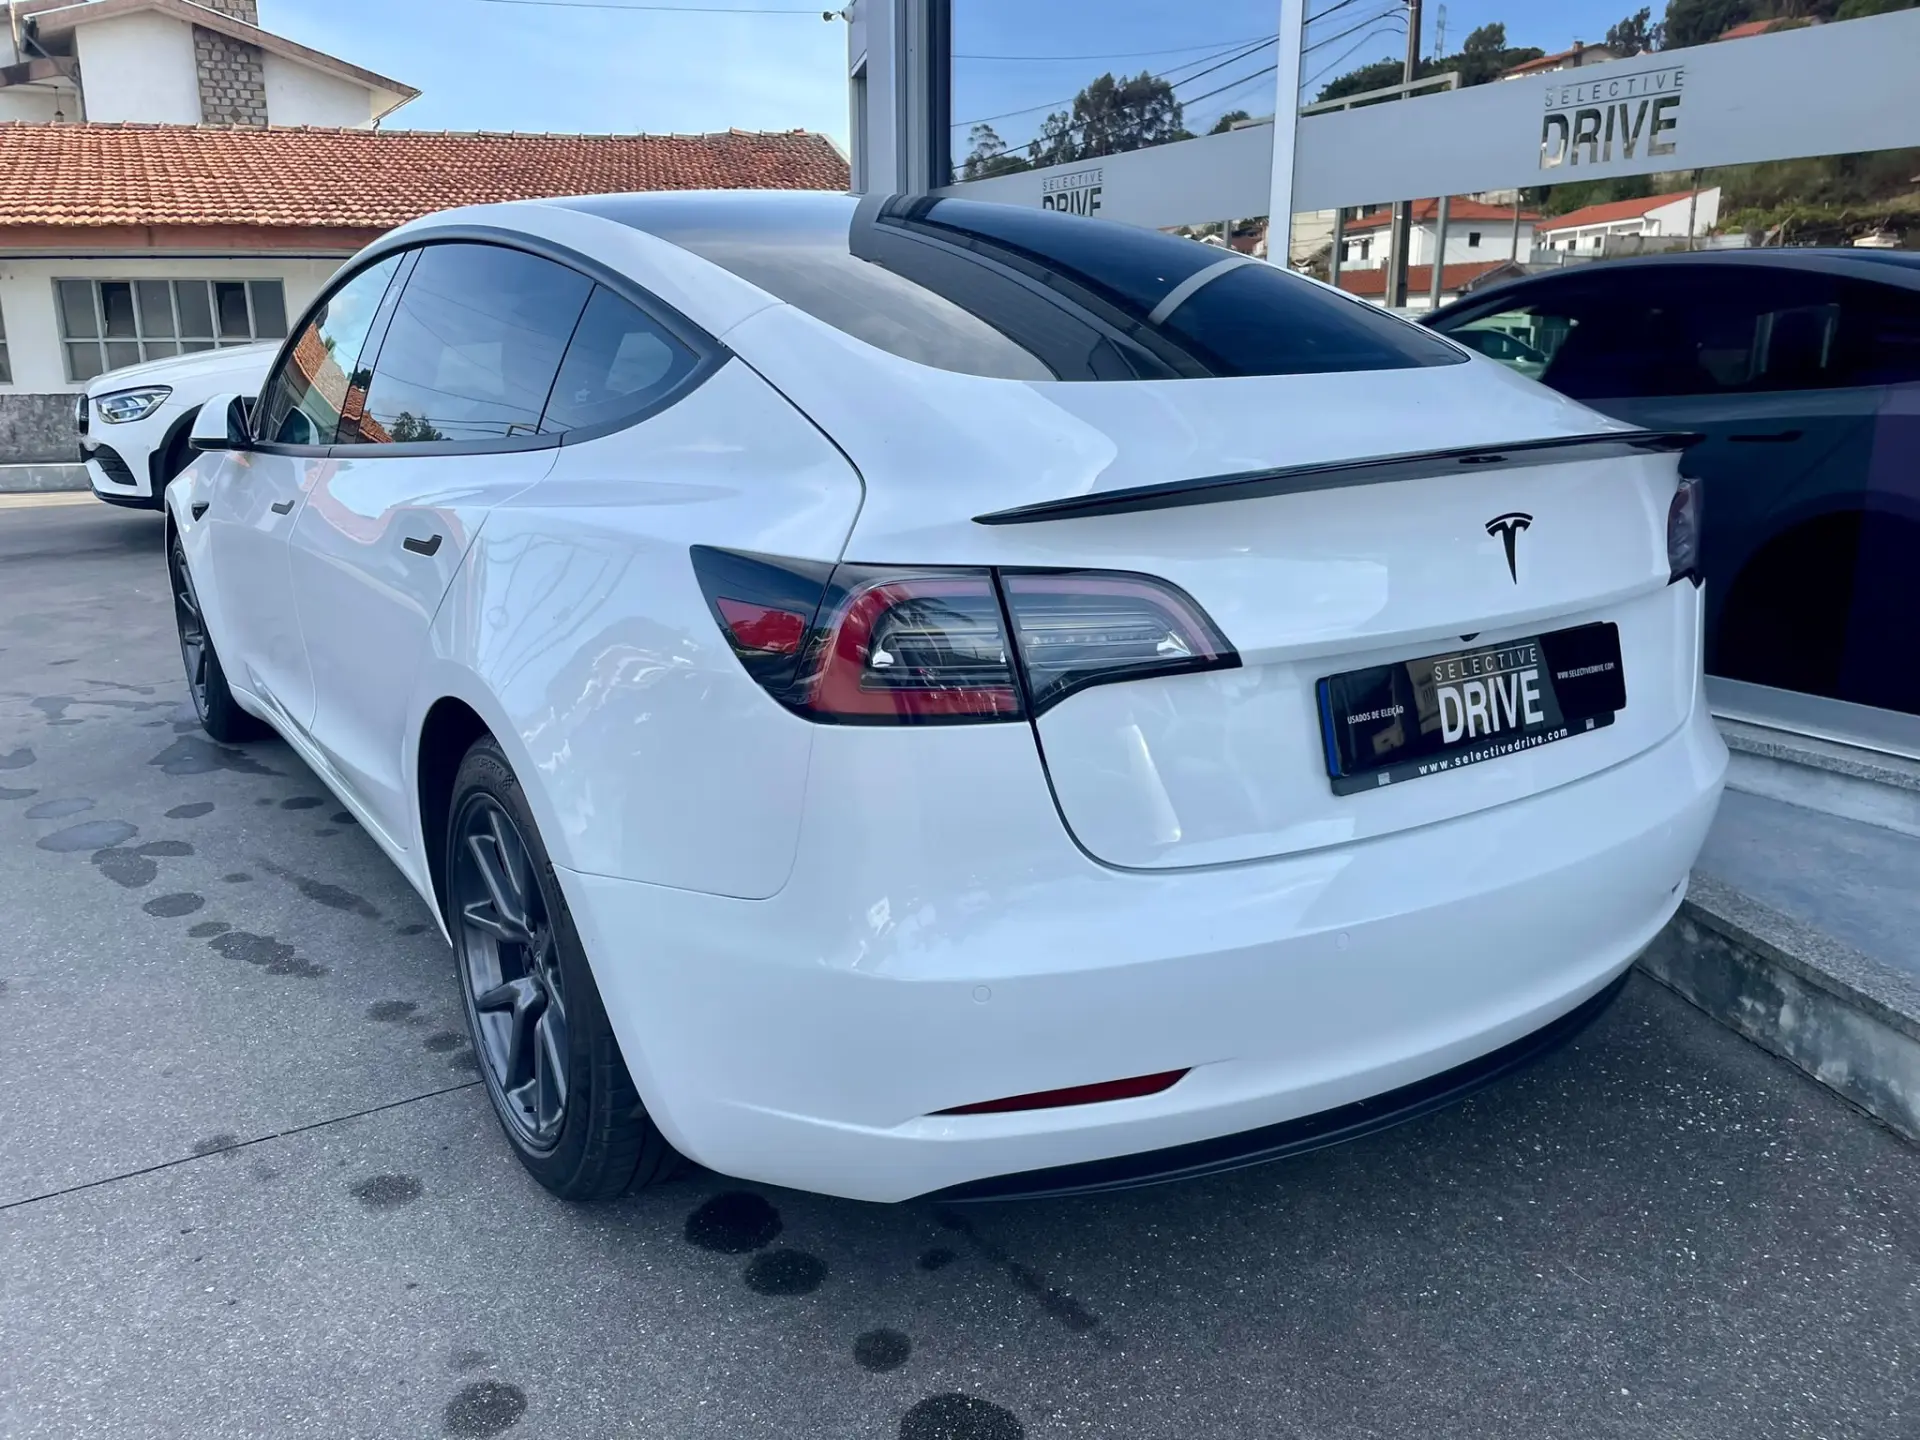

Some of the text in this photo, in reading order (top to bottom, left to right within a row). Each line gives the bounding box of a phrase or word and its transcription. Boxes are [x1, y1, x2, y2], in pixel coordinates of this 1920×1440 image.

[1544, 71, 1685, 108] SELECTIVE
[1539, 95, 1681, 170] DRIVE
[1043, 171, 1103, 191] SELECTIVE
[1435, 648, 1537, 681] SELECTIVE
[1347, 704, 1404, 724] USADOS DE ELEIÇÃO
[1437, 669, 1544, 744] DRIVE
[1418, 727, 1568, 775] www.selectivedrive.com
